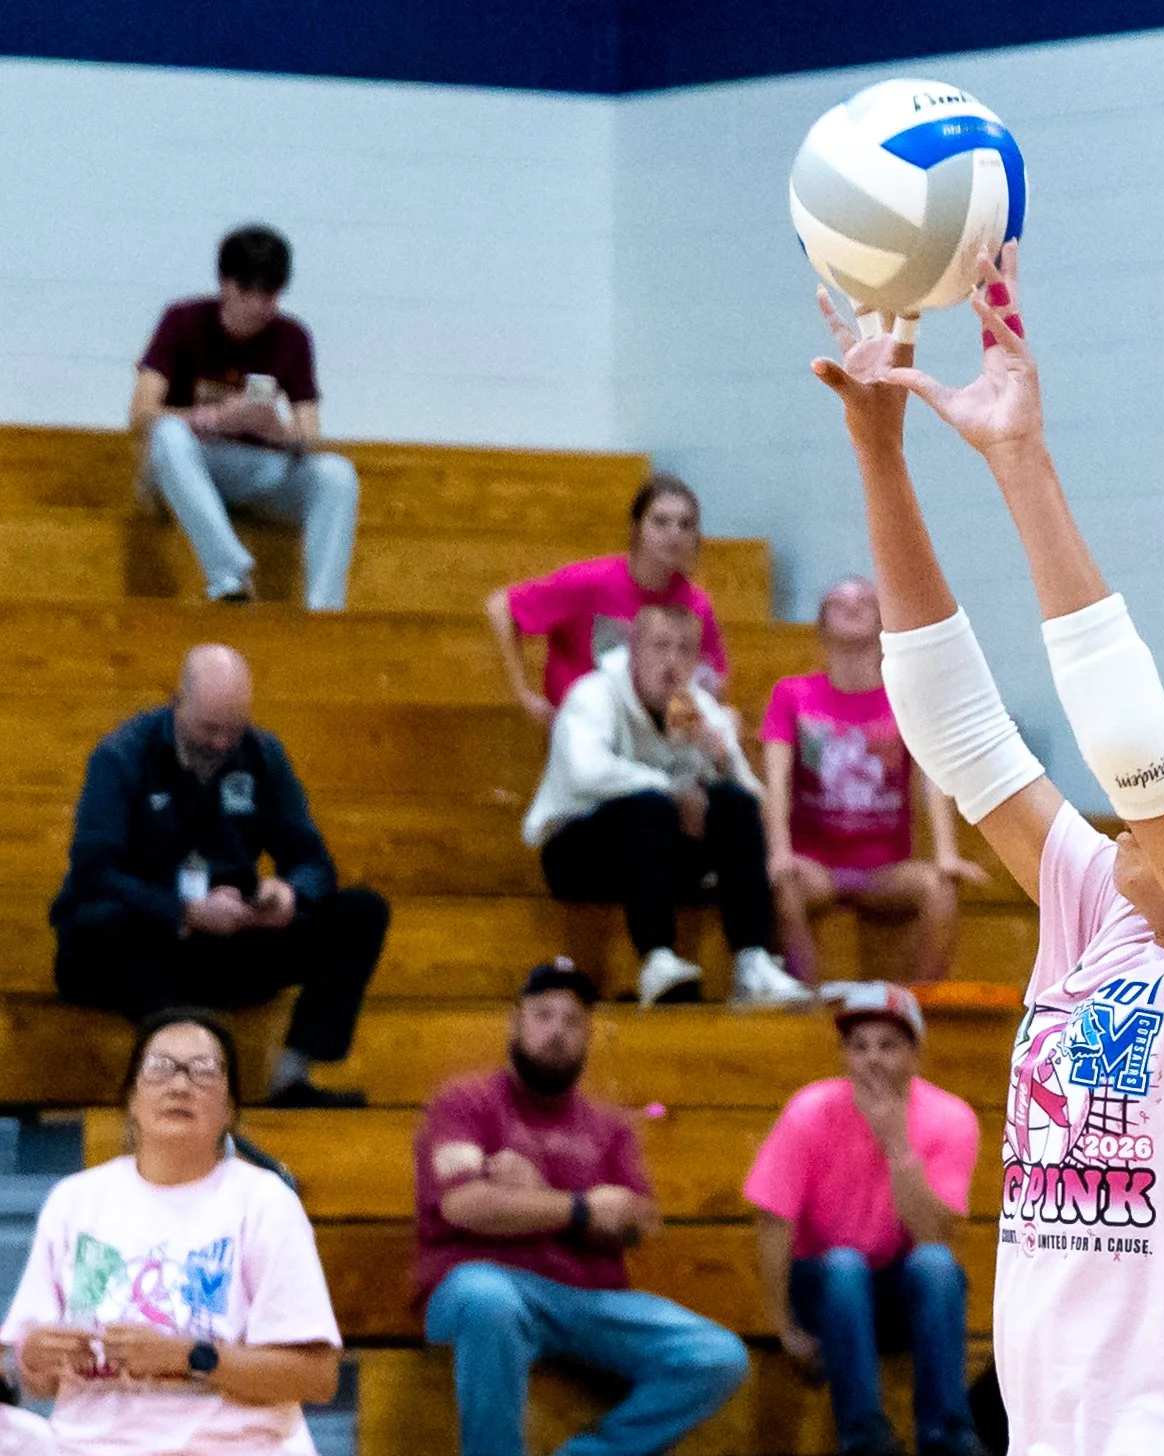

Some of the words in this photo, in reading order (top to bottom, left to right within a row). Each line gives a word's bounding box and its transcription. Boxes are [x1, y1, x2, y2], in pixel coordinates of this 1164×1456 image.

[1126, 1018, 1151, 1085] CORSAIRS
[1083, 1133, 1154, 1161] 2026
[1037, 1233, 1067, 1250] UNITED
[1070, 1235, 1089, 1250] FOR
[1094, 1237, 1102, 1252] A
[1107, 1237, 1153, 1255] CAUSE.
